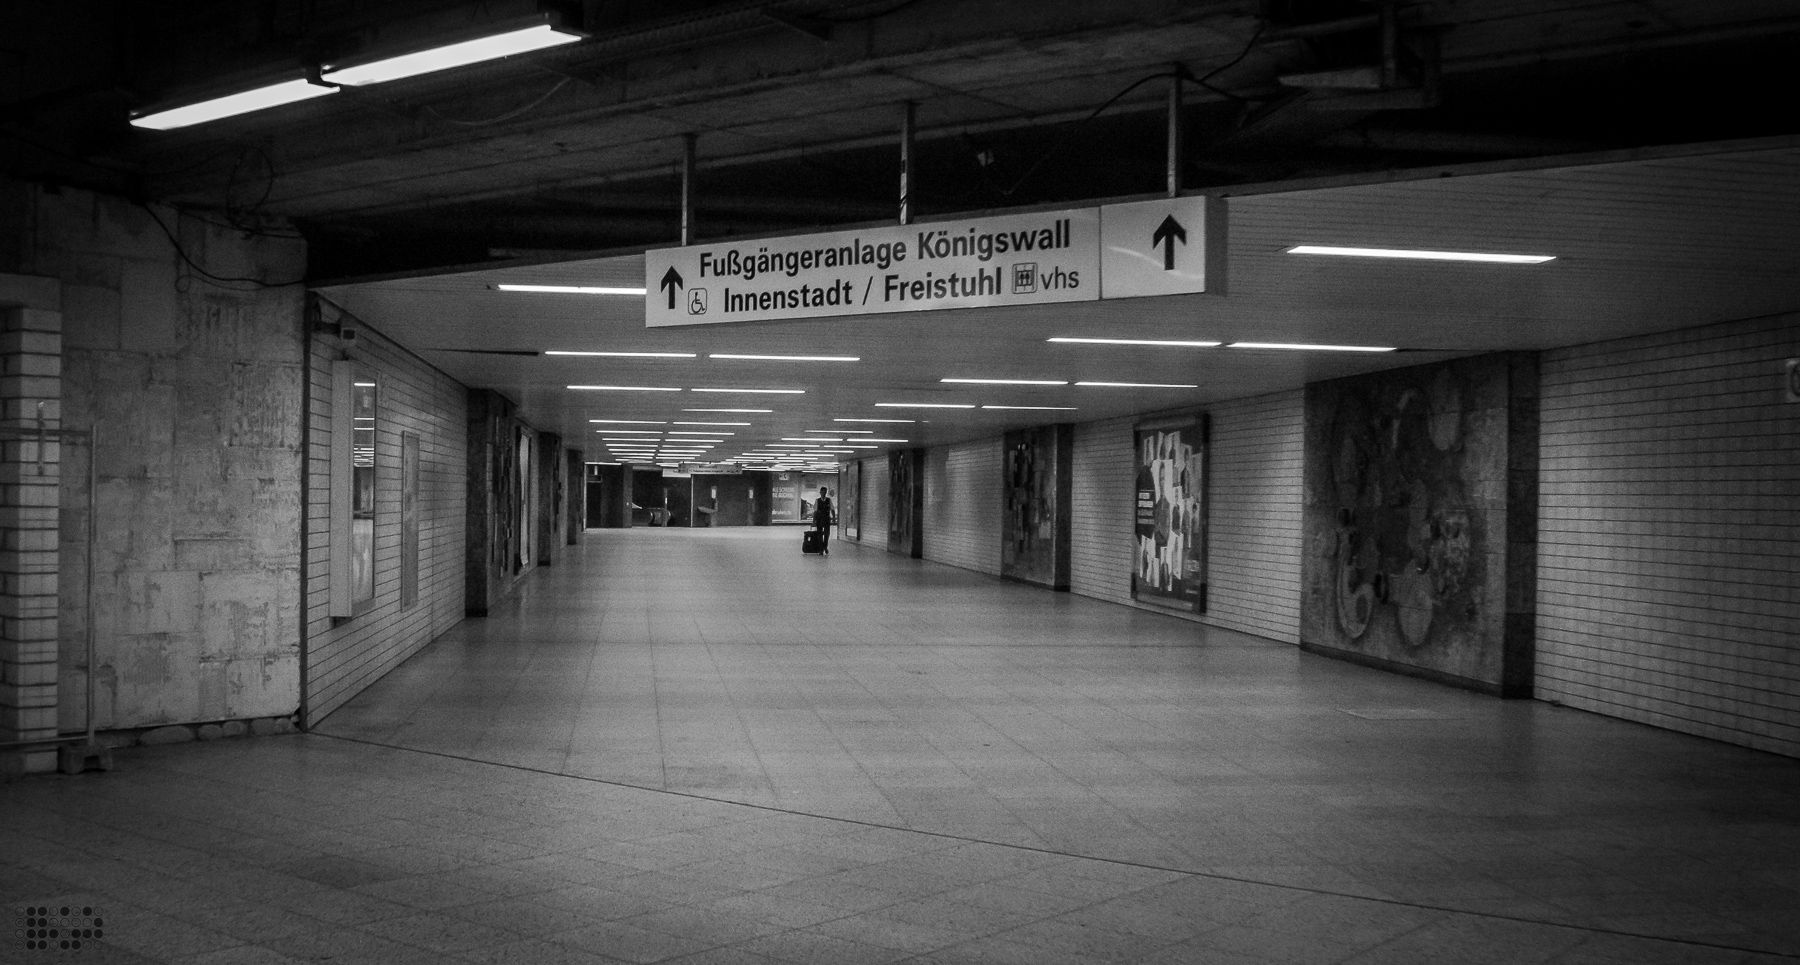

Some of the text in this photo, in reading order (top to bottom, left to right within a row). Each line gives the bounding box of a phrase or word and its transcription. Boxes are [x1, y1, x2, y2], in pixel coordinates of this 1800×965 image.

[700, 218, 1071, 281] Fußgängeranlage Königswall
[724, 266, 1080, 313] Innenstadt / Freistuhl vhs
